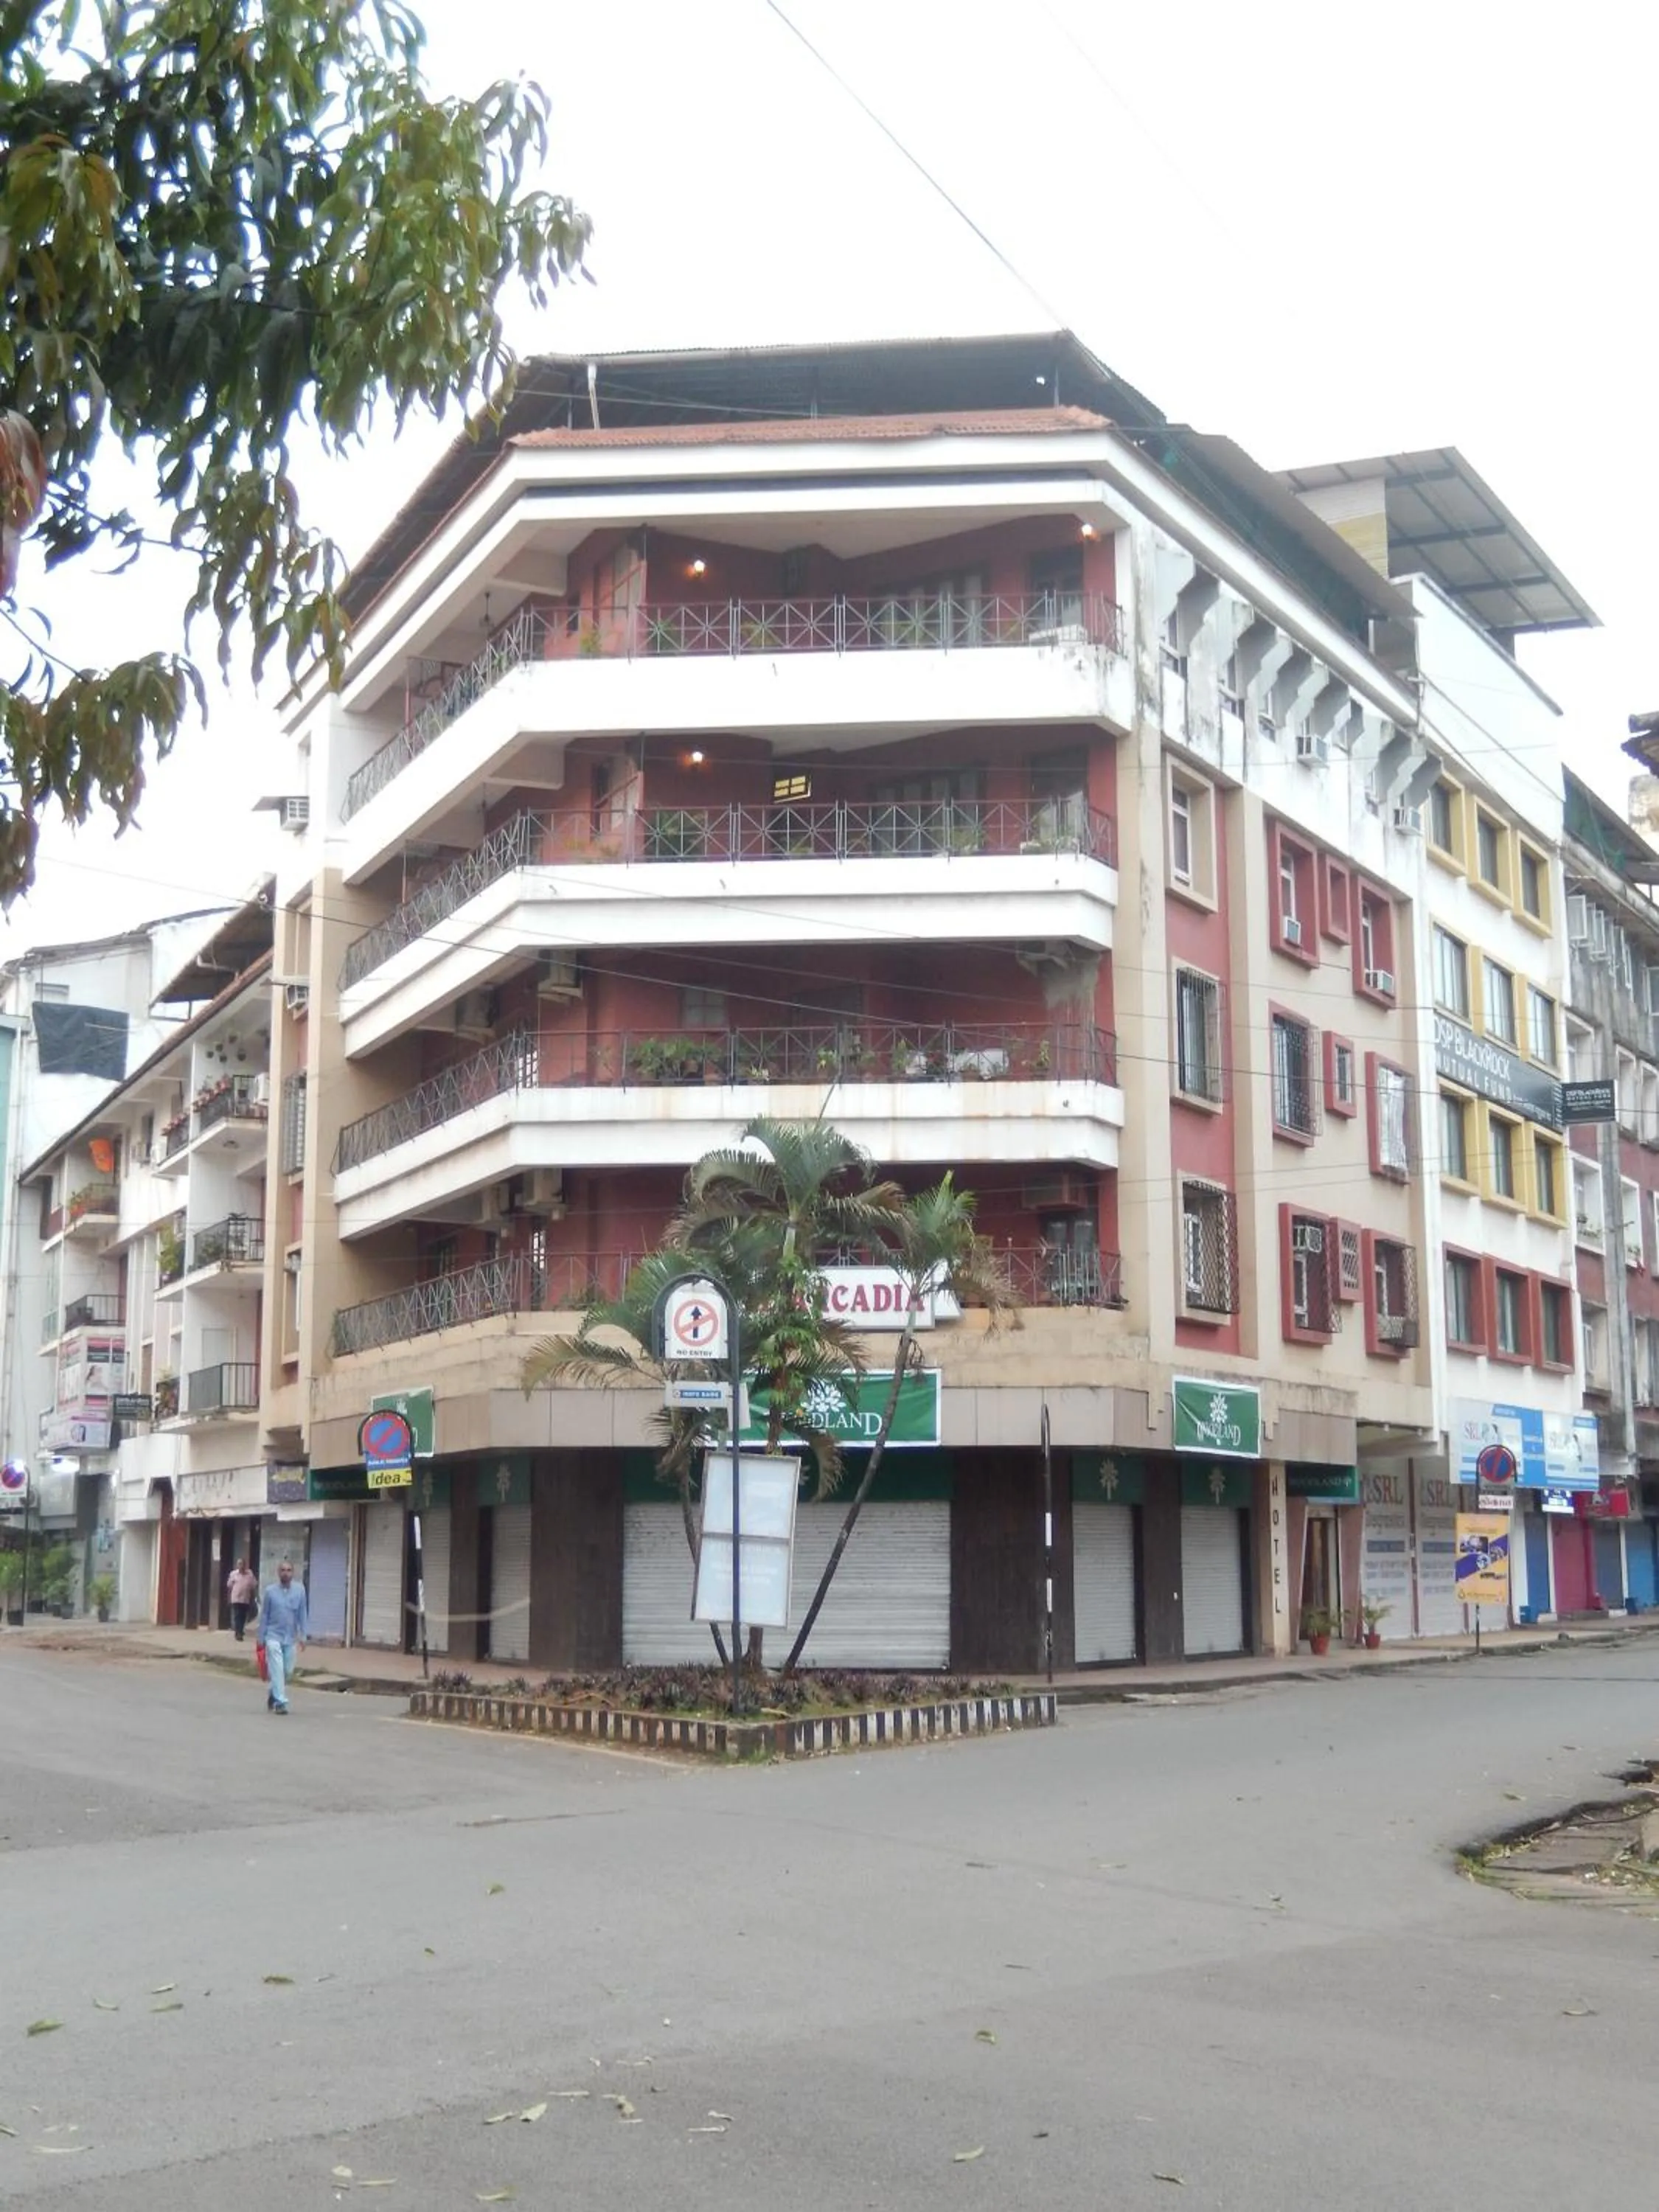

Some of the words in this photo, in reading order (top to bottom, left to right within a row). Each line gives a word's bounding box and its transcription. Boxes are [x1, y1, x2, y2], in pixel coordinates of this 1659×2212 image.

[1436, 1049, 1480, 1088] MUTUAL
[1484, 1076, 1512, 1103] FUND
[771, 1411, 883, 1436] DLAND
[1372, 1475, 1405, 1504] SRL
[1271, 1474, 1281, 1614] HOTEL
